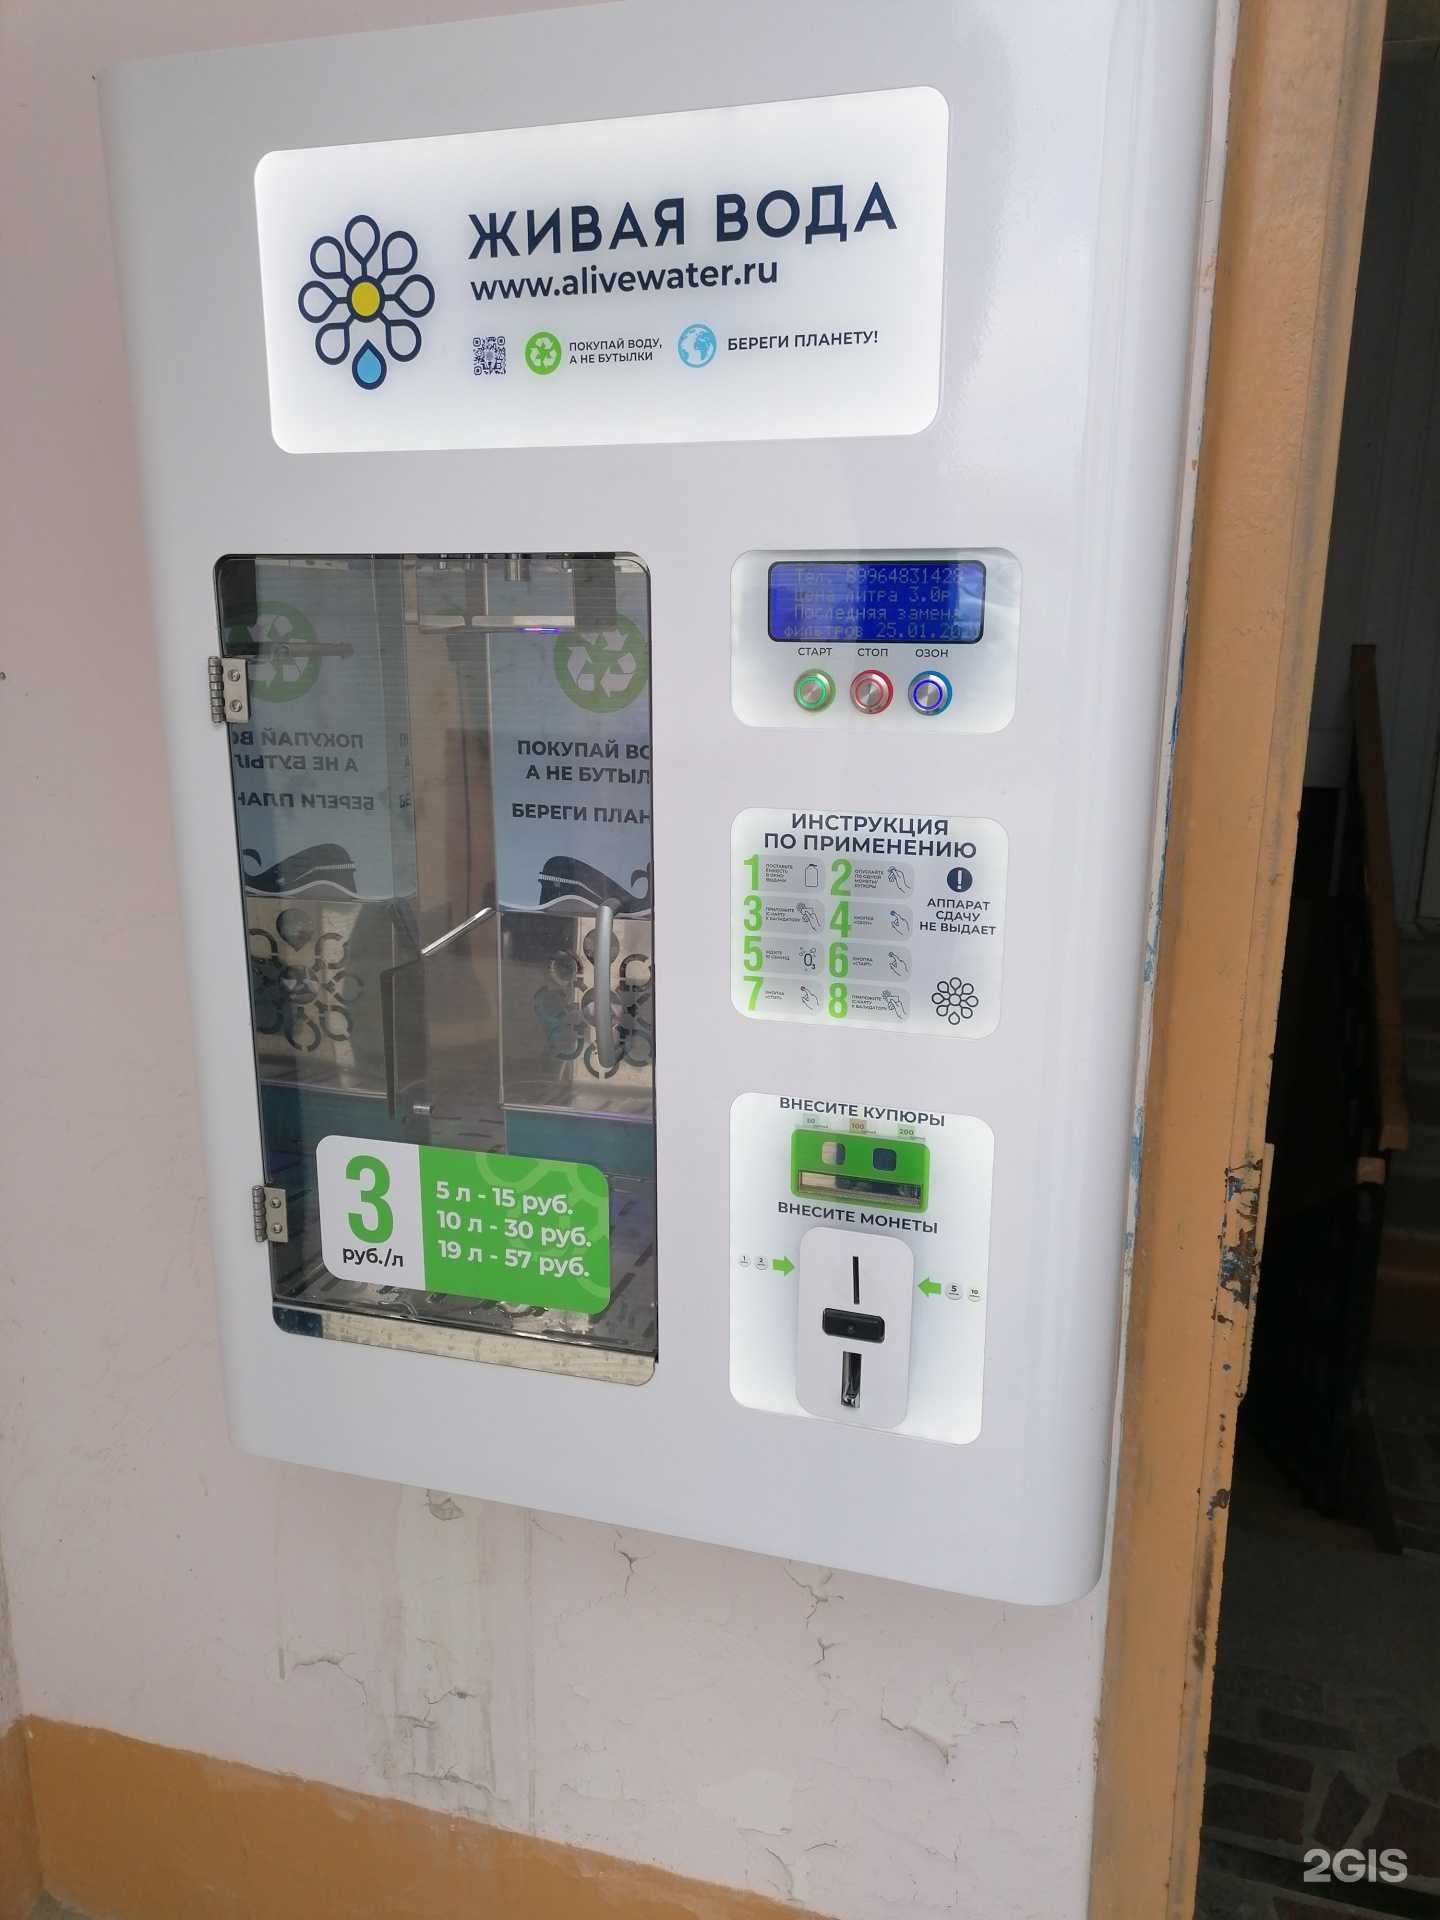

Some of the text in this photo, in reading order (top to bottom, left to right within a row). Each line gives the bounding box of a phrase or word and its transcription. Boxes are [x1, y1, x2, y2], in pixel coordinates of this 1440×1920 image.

[467, 181, 898, 260] ЖИВАЯ ВОДА
[470, 261, 778, 301] www.alivewater.ru
[569, 337, 663, 351] ПОКУПАЙ ВОДУ,
[728, 330, 879, 351] БЕРЕГИ ПЛАНЕТУ!
[569, 351, 653, 364] А НЕ БУТЫЛКИ
[797, 647, 833, 657] СТАРТ
[857, 648, 889, 658] СТОП
[915, 649, 949, 658] ОЗОН
[517, 739, 619, 759] ПОКУПАЙ
[526, 764, 540, 780] А
[546, 766, 572, 781] НЕ
[512, 803, 587, 821] БЕРЕГИ
[791, 813, 949, 837] ИНСТРУКЦИЯ
[764, 833, 977, 859] ПО ПРИМЕНЕНИЮ
[744, 854, 759, 891] 1
[831, 859, 852, 896] 2
[743, 895, 763, 931] 3
[830, 901, 850, 938] 4
[927, 898, 991, 911] АППАРАТ
[935, 910, 981, 922] СДАЧУ
[919, 921, 997, 936] НЕ ВЫДАЕТ
[743, 936, 763, 972] 5
[828, 942, 849, 978] 6
[743, 976, 764, 1012] 7
[828, 983, 848, 1019] 8
[780, 1096, 945, 1127] ВНЕСИТЕ КУПЮРЫ
[345, 1155, 393, 1244] 3
[436, 1181, 449, 1200] 5
[456, 1187, 470, 1203] л
[491, 1187, 516, 1209] 15
[522, 1193, 573, 1215] руб.
[436, 1210, 461, 1230] 10
[467, 1217, 482, 1233] л
[504, 1219, 533, 1240] 30
[540, 1225, 592, 1248] руб.
[778, 1201, 938, 1234] ВНЕСИТЕ МОНЕТЫ
[343, 1247, 404, 1268] руб./л
[437, 1239, 461, 1259] 19
[467, 1247, 483, 1264] л
[504, 1249, 532, 1268] 57
[539, 1255, 590, 1277] руб.
